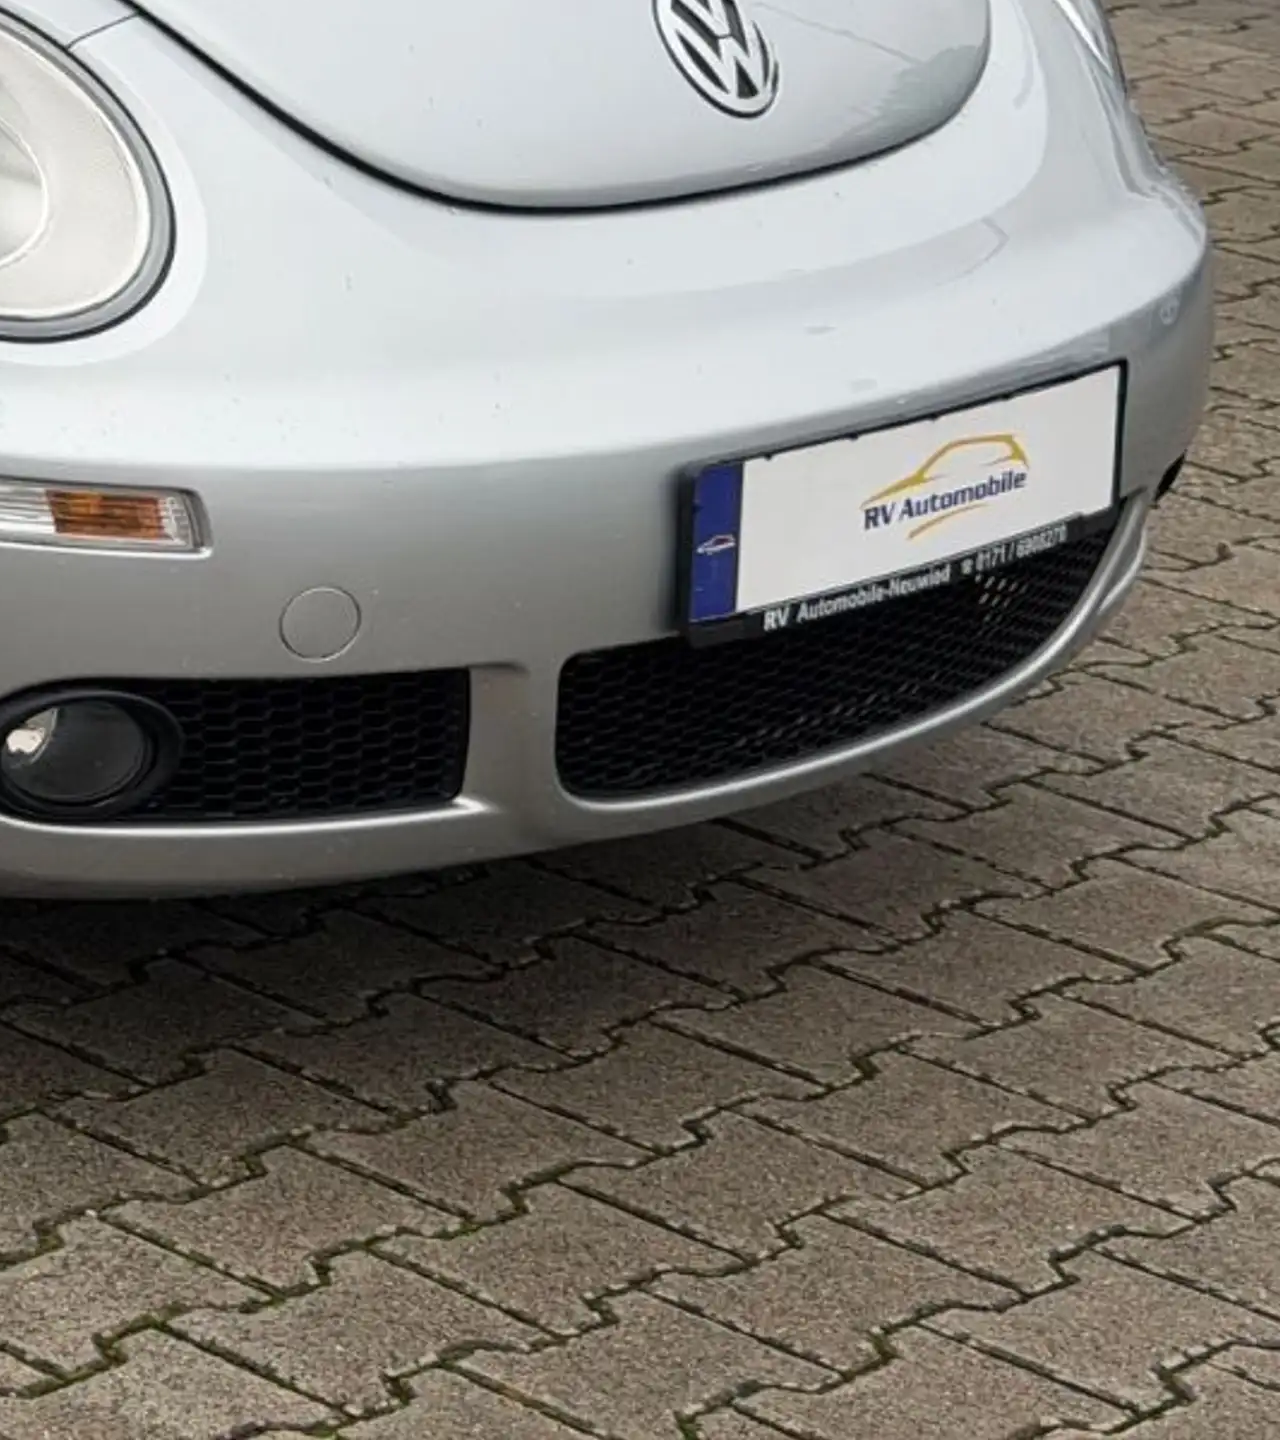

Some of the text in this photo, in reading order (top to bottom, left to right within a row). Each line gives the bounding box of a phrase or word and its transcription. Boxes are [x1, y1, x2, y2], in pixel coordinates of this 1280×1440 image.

[863, 470, 1028, 530] RV Automobile
[763, 603, 791, 632] RV
